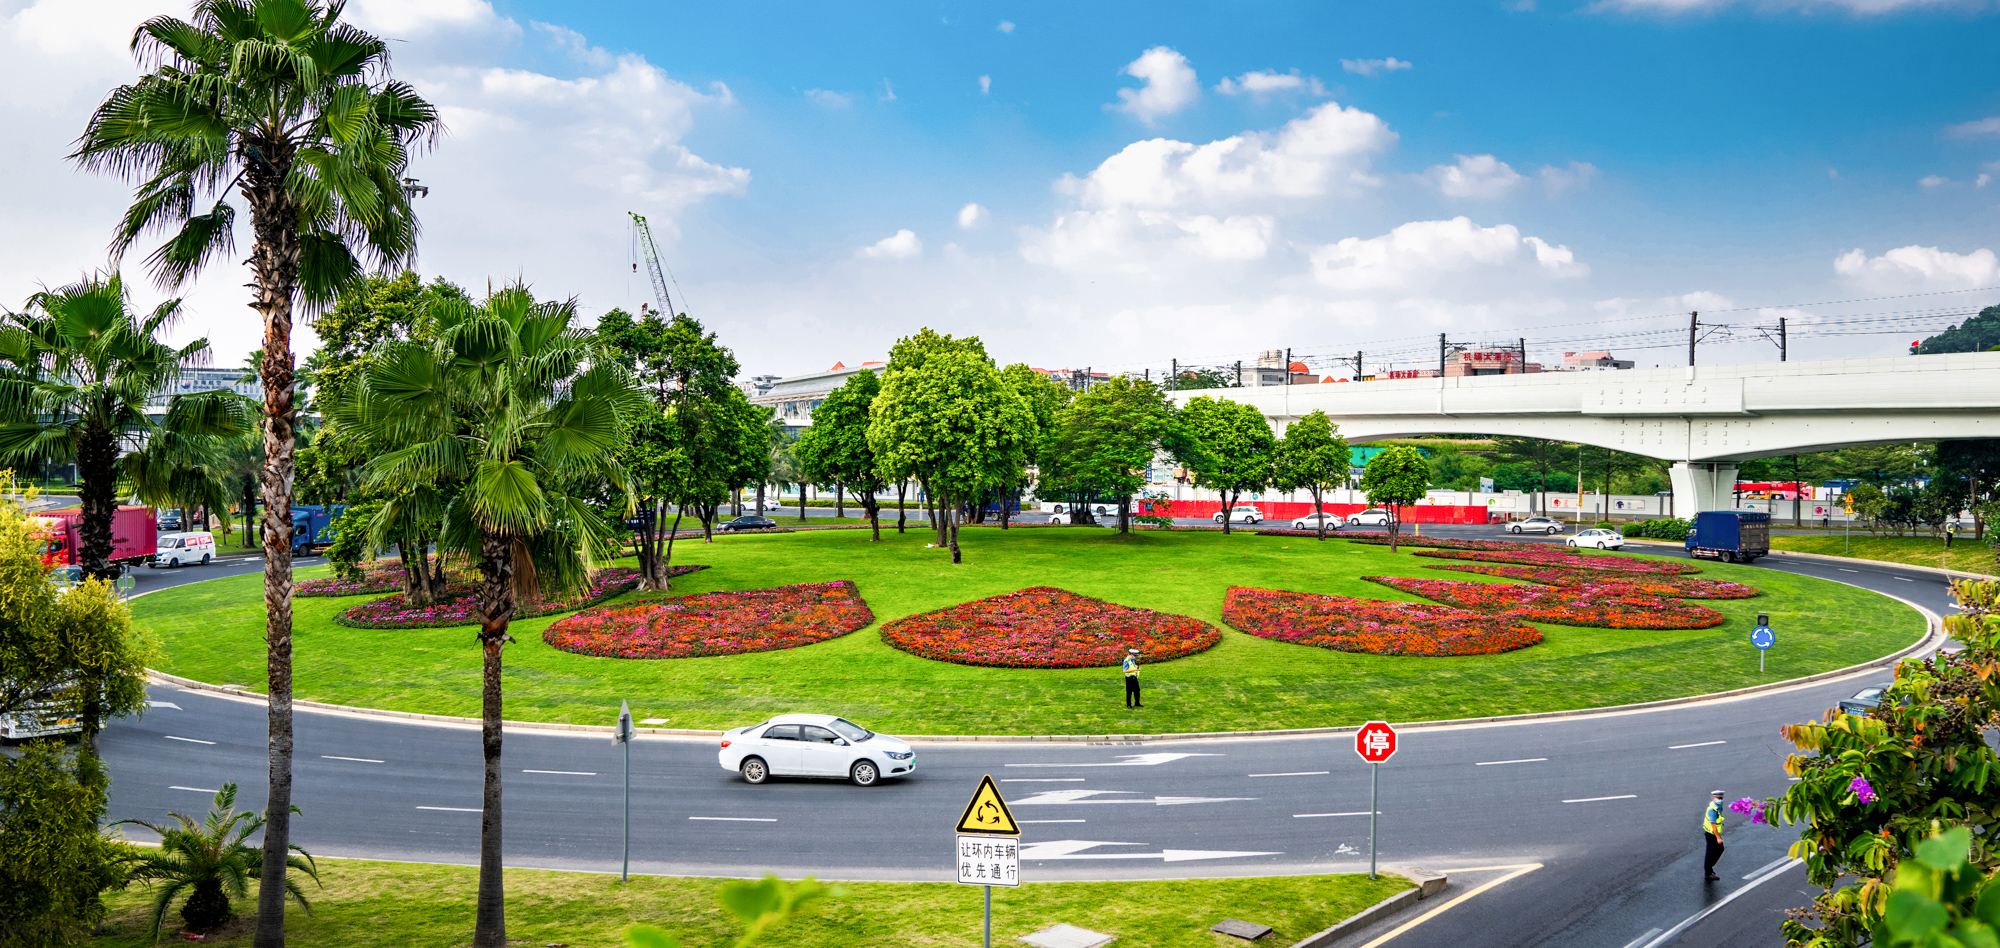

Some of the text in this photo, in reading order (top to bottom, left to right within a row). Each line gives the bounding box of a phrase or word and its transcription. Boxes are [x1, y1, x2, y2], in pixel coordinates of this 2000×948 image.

[1363, 729, 1390, 756] 停
[961, 842, 1016, 860] 让环内车辆
[961, 861, 1016, 879] 优先通行
